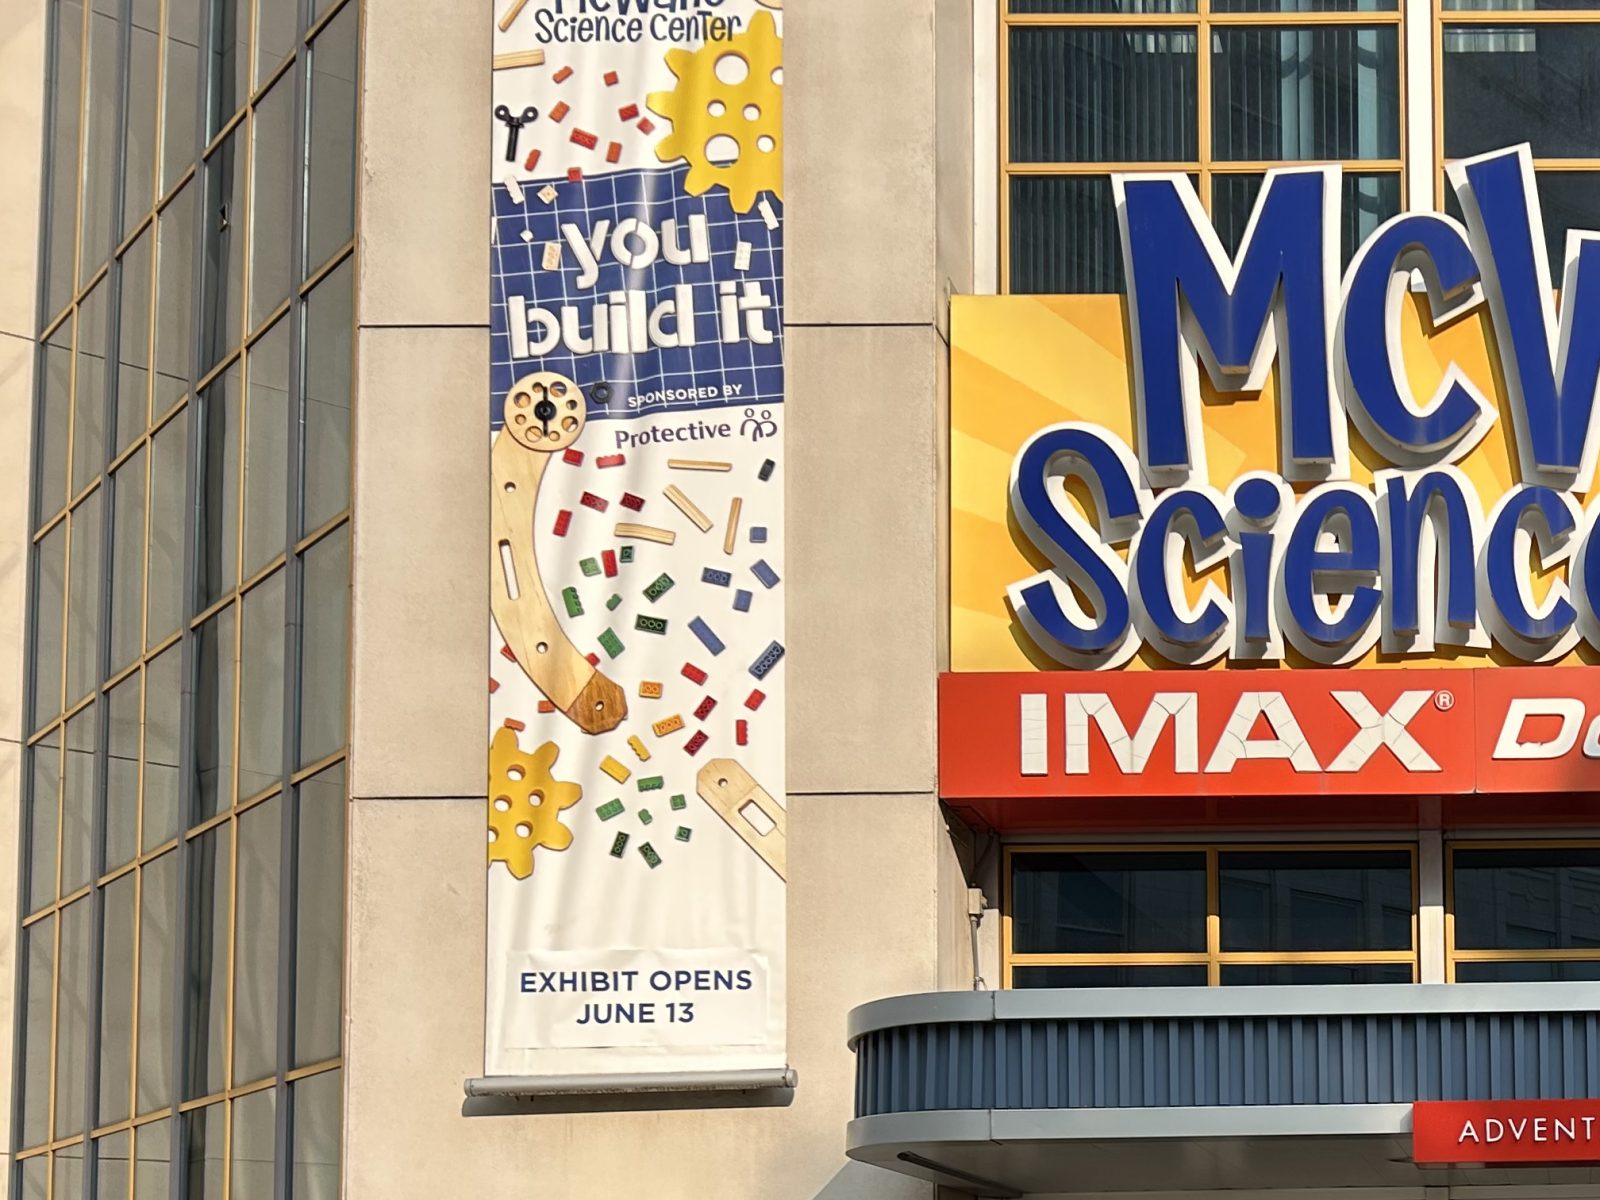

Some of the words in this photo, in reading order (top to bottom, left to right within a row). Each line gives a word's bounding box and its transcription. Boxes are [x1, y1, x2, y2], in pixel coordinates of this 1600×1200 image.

[535, 8, 643, 43] Science
[650, 11, 742, 42] Center
[561, 214, 710, 289] you
[508, 284, 696, 359] build
[719, 280, 774, 344] it
[628, 384, 719, 408] SPONSORED
[722, 384, 743, 397] BY
[615, 420, 731, 449] Protective
[520, 971, 639, 993] EXHIBIT
[649, 970, 753, 990] OPENS
[576, 1003, 656, 1024] JUNE
[665, 1002, 695, 1023] 13
